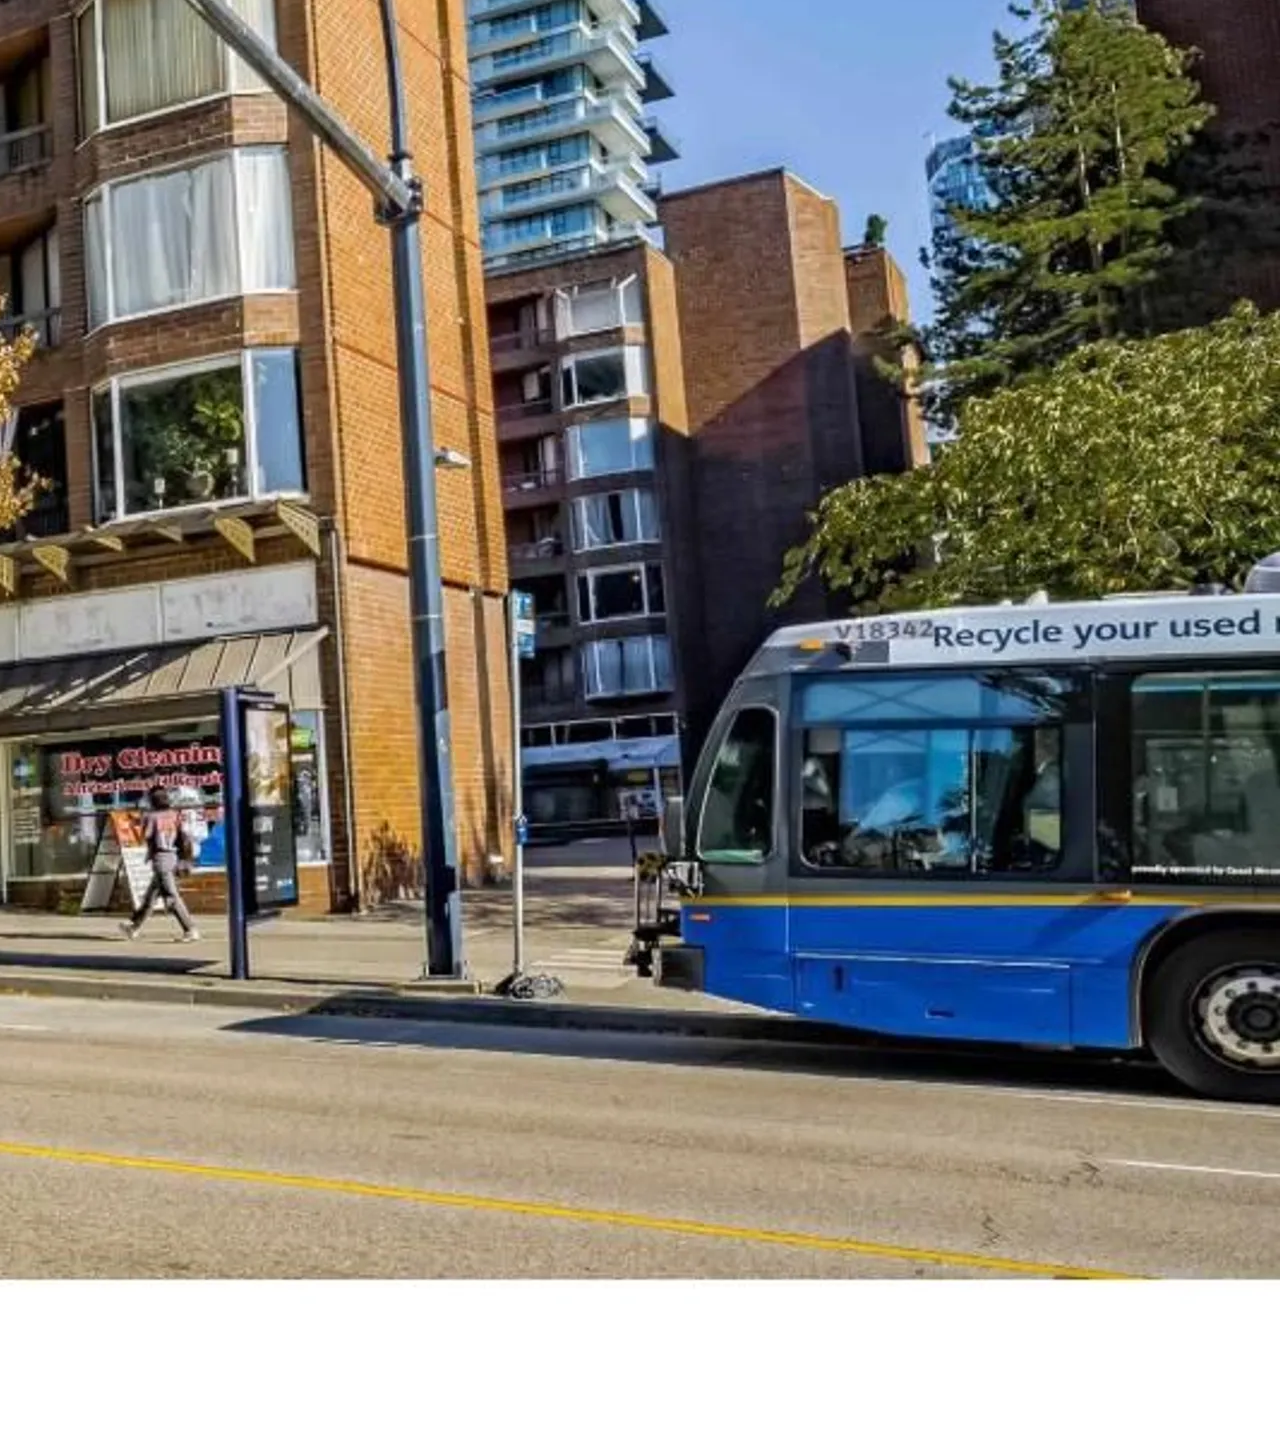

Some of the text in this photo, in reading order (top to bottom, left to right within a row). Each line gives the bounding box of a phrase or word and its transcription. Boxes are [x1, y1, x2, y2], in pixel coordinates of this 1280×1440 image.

[834, 619, 933, 641] V18342
[934, 620, 1063, 653] Recycle
[1072, 620, 1159, 650] your
[1169, 608, 1261, 638] used
[60, 742, 225, 775] Dry Cleanin
